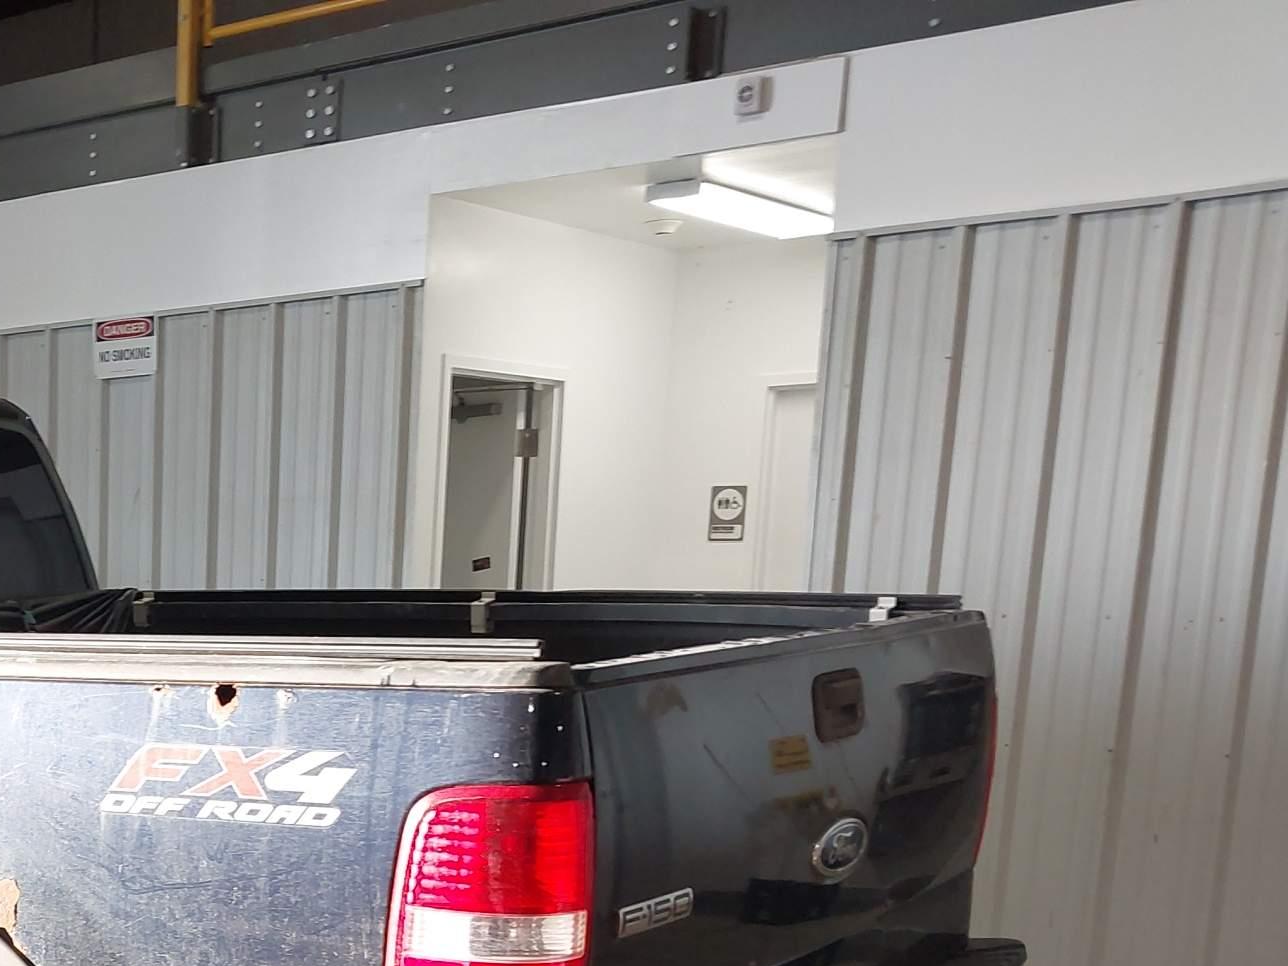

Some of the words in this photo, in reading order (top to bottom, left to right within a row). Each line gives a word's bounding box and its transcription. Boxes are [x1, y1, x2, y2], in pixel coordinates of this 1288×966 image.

[102, 321, 147, 337] DANGER
[98, 349, 111, 363] NO
[112, 346, 152, 362] SMOKING
[109, 743, 358, 804] FX4
[98, 792, 192, 815] OFF
[196, 799, 342, 828] ROAD
